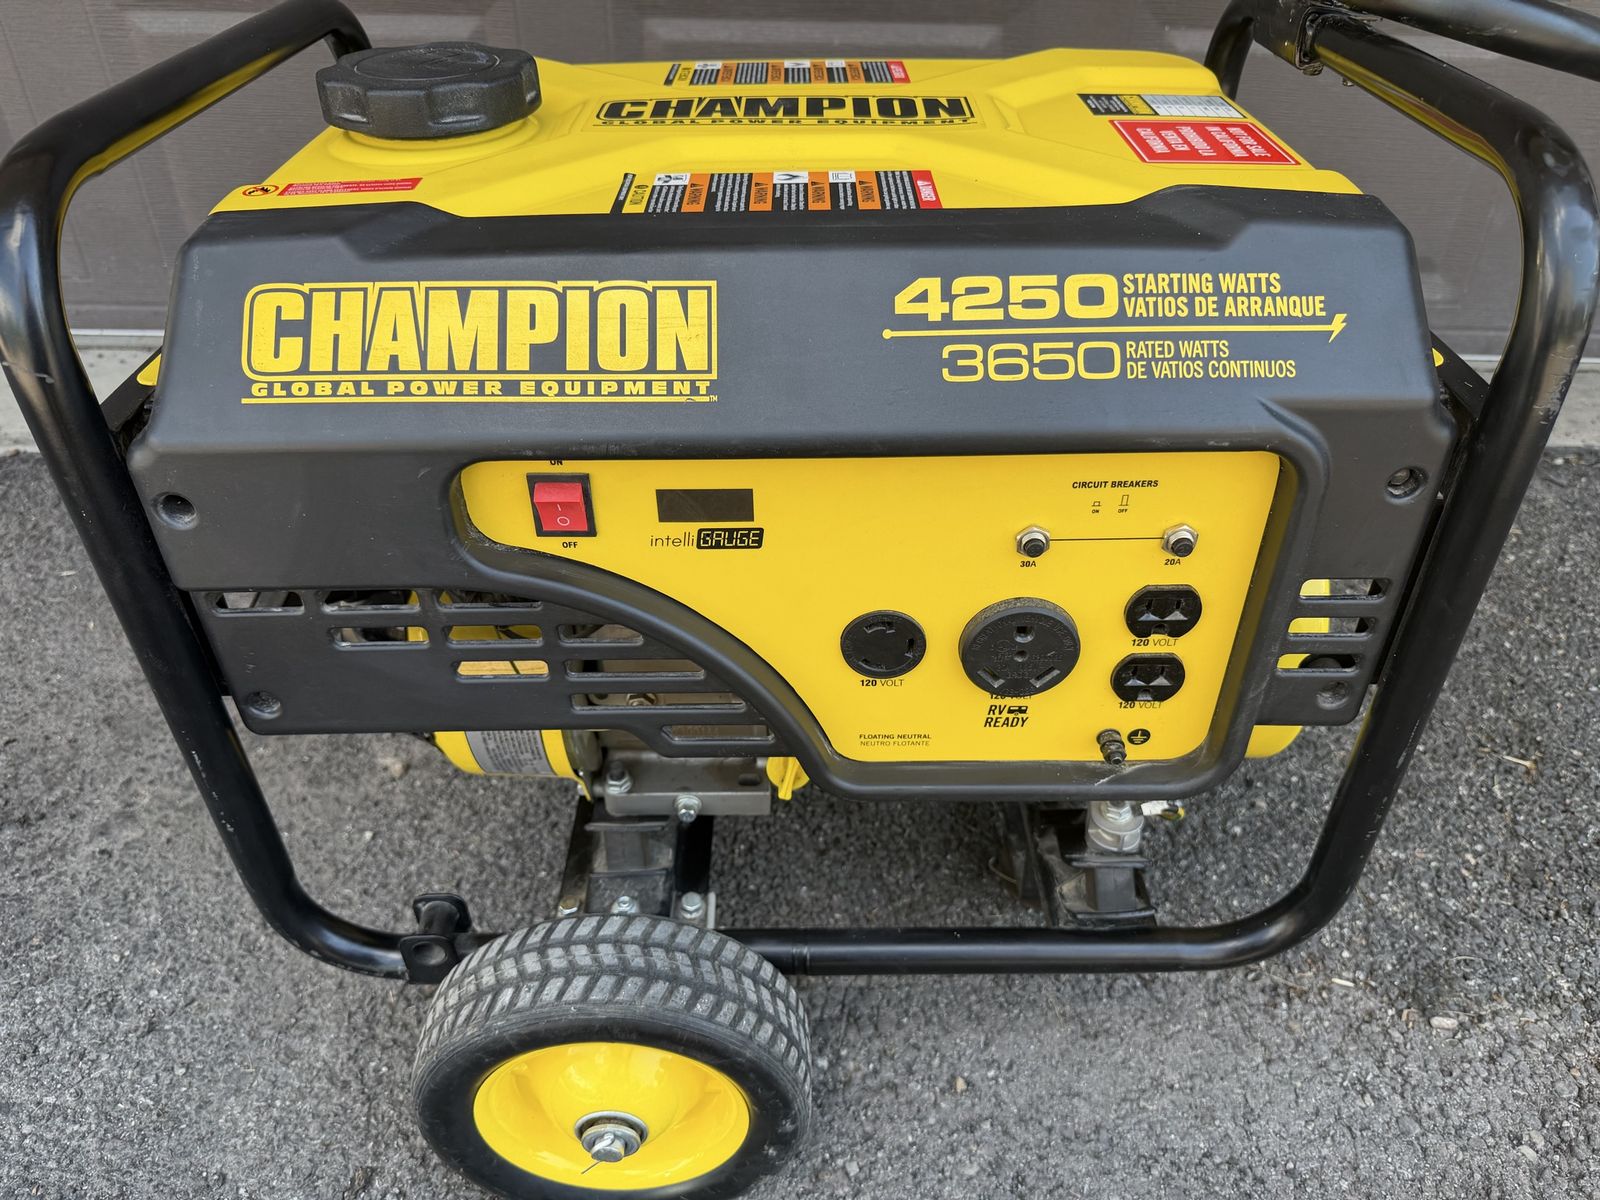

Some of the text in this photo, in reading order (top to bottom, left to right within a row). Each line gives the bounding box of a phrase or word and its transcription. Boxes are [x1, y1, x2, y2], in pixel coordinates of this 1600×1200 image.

[603, 97, 967, 119] CHAMPION
[686, 187, 703, 206] WARNING
[753, 187, 768, 204] WARNING
[811, 186, 826, 203] WARNING
[860, 185, 875, 203] WARNING
[919, 185, 937, 201] DANGER
[1122, 272, 1281, 294] STARTING WATTS
[894, 273, 1119, 321] 4250
[1123, 295, 1326, 318] VATIOS DE ARRANQUE
[250, 288, 709, 374] CHAMPION
[1126, 340, 1229, 358] RATED WATTS
[942, 341, 1121, 382] 3650
[1126, 359, 1297, 379] DE VATIOS CONTINUOS
[251, 380, 710, 397] GLOBAL POWER EQUIPMENT
[1071, 480, 1159, 489] CIRCUIT BREAKERS
[562, 541, 578, 549] OFF
[1020, 560, 1037, 568] 30A
[1164, 558, 1181, 566] 20A
[1131, 638, 1179, 647] 120 VOLT
[860, 679, 905, 687] 120 VOLT
[987, 704, 1007, 716] RV
[1118, 701, 1162, 709] 120 VOLT
[983, 716, 1029, 728] READY
